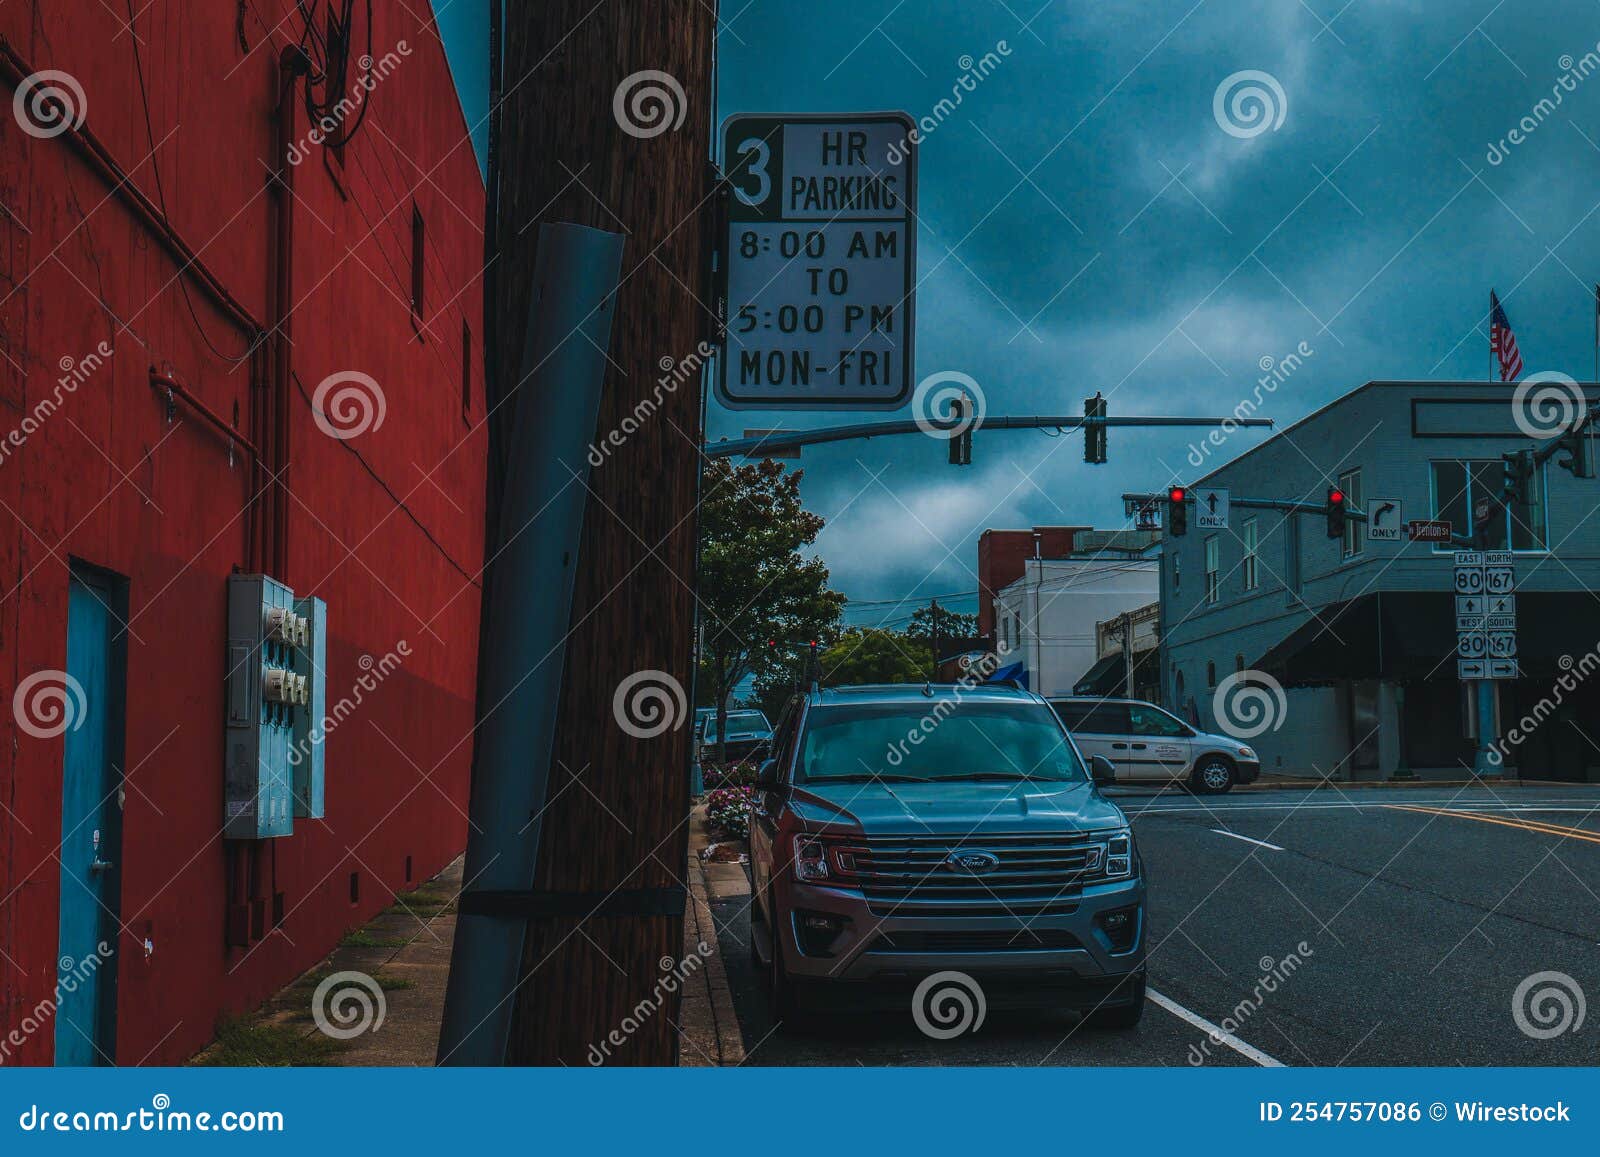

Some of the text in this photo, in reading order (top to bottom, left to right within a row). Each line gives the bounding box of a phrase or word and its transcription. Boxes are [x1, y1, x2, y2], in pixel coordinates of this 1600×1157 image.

[822, 131, 867, 166] HR
[734, 137, 771, 206] 3
[791, 175, 897, 211] PARKING
[740, 230, 897, 259] 8:00 AM
[806, 268, 848, 296] TO
[738, 304, 893, 333] 5:00 PM
[740, 350, 891, 386] MON-FRI
[1200, 516, 1224, 527] ONLY
[1372, 528, 1397, 538] ONLY
[1458, 554, 1479, 563] EAST
[1486, 554, 1512, 563] NORTH
[1457, 573, 1480, 588] 80
[1488, 573, 1511, 588] 167
[1460, 618, 1482, 627] WEST
[1488, 617, 1514, 627] SOUTH
[1460, 637, 1484, 652] 80
[1491, 637, 1514, 652] 167
